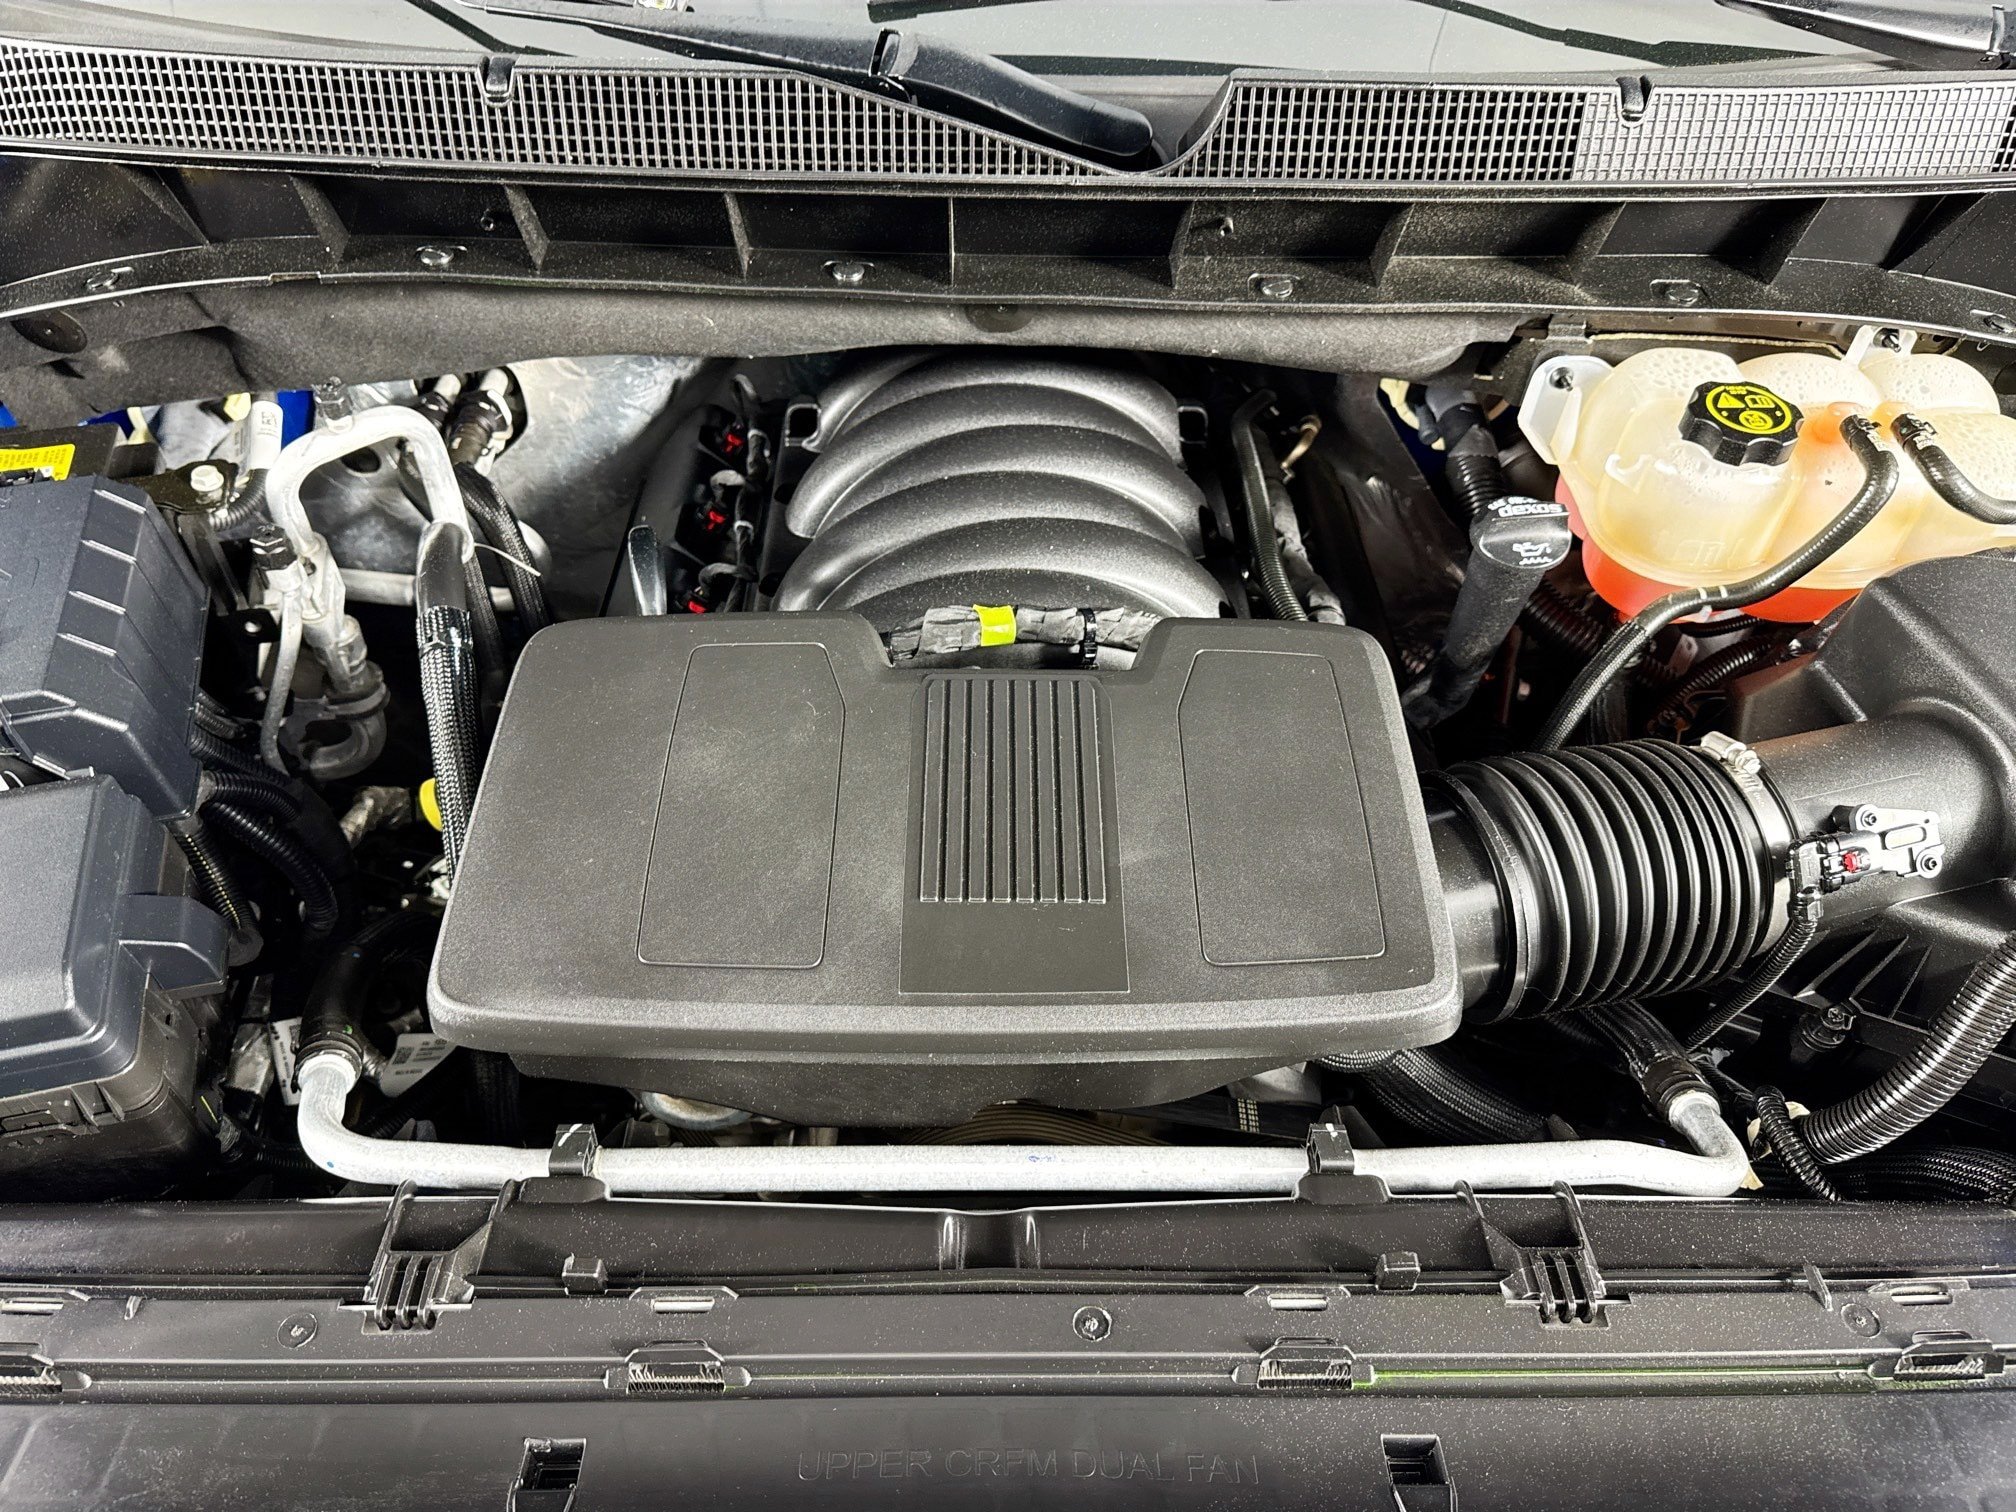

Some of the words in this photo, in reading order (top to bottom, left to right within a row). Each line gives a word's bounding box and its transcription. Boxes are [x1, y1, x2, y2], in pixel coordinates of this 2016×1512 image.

[1498, 504, 1562, 516] dexos
[798, 1450, 932, 1481] UPPER
[945, 1449, 1058, 1477] CRFM
[1073, 1450, 1175, 1481] DUAL
[1188, 1454, 1259, 1484] FAN
